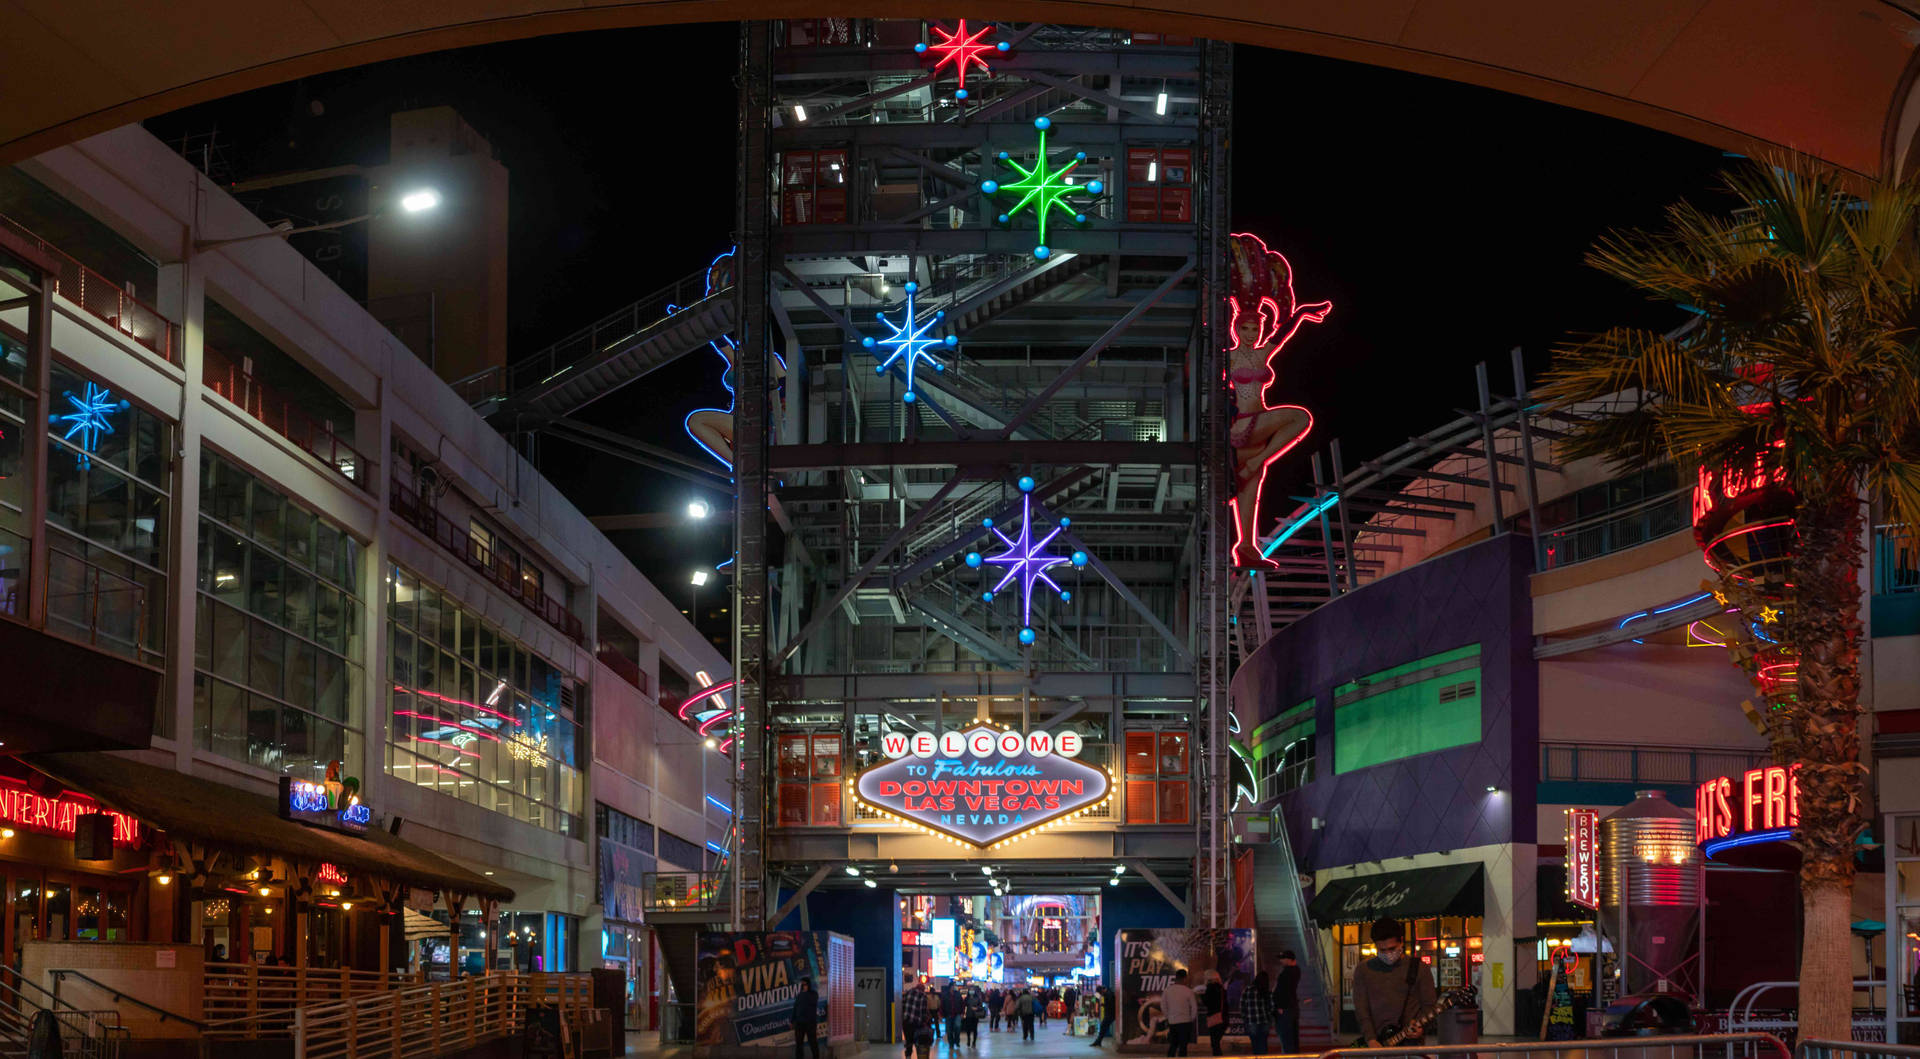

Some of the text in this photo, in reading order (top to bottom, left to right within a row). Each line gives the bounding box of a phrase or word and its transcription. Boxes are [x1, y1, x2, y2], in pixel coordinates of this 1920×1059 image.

[886, 736, 1075, 753] WELCOME
[906, 759, 1042, 780] TO Fabulous
[879, 779, 1084, 796] DOWNTOWN
[904, 796, 1061, 811] LAS VEGAS
[1744, 763, 1803, 832] FRE
[940, 813, 1024, 825] NEVADA
[1578, 815, 1590, 900] BREWERY
[1124, 941, 1151, 958] IT'S
[1129, 958, 1164, 975] PLAY
[741, 959, 789, 995] VIVA
[857, 978, 881, 991] 477
[738, 983, 803, 1012] DOWNTOW
